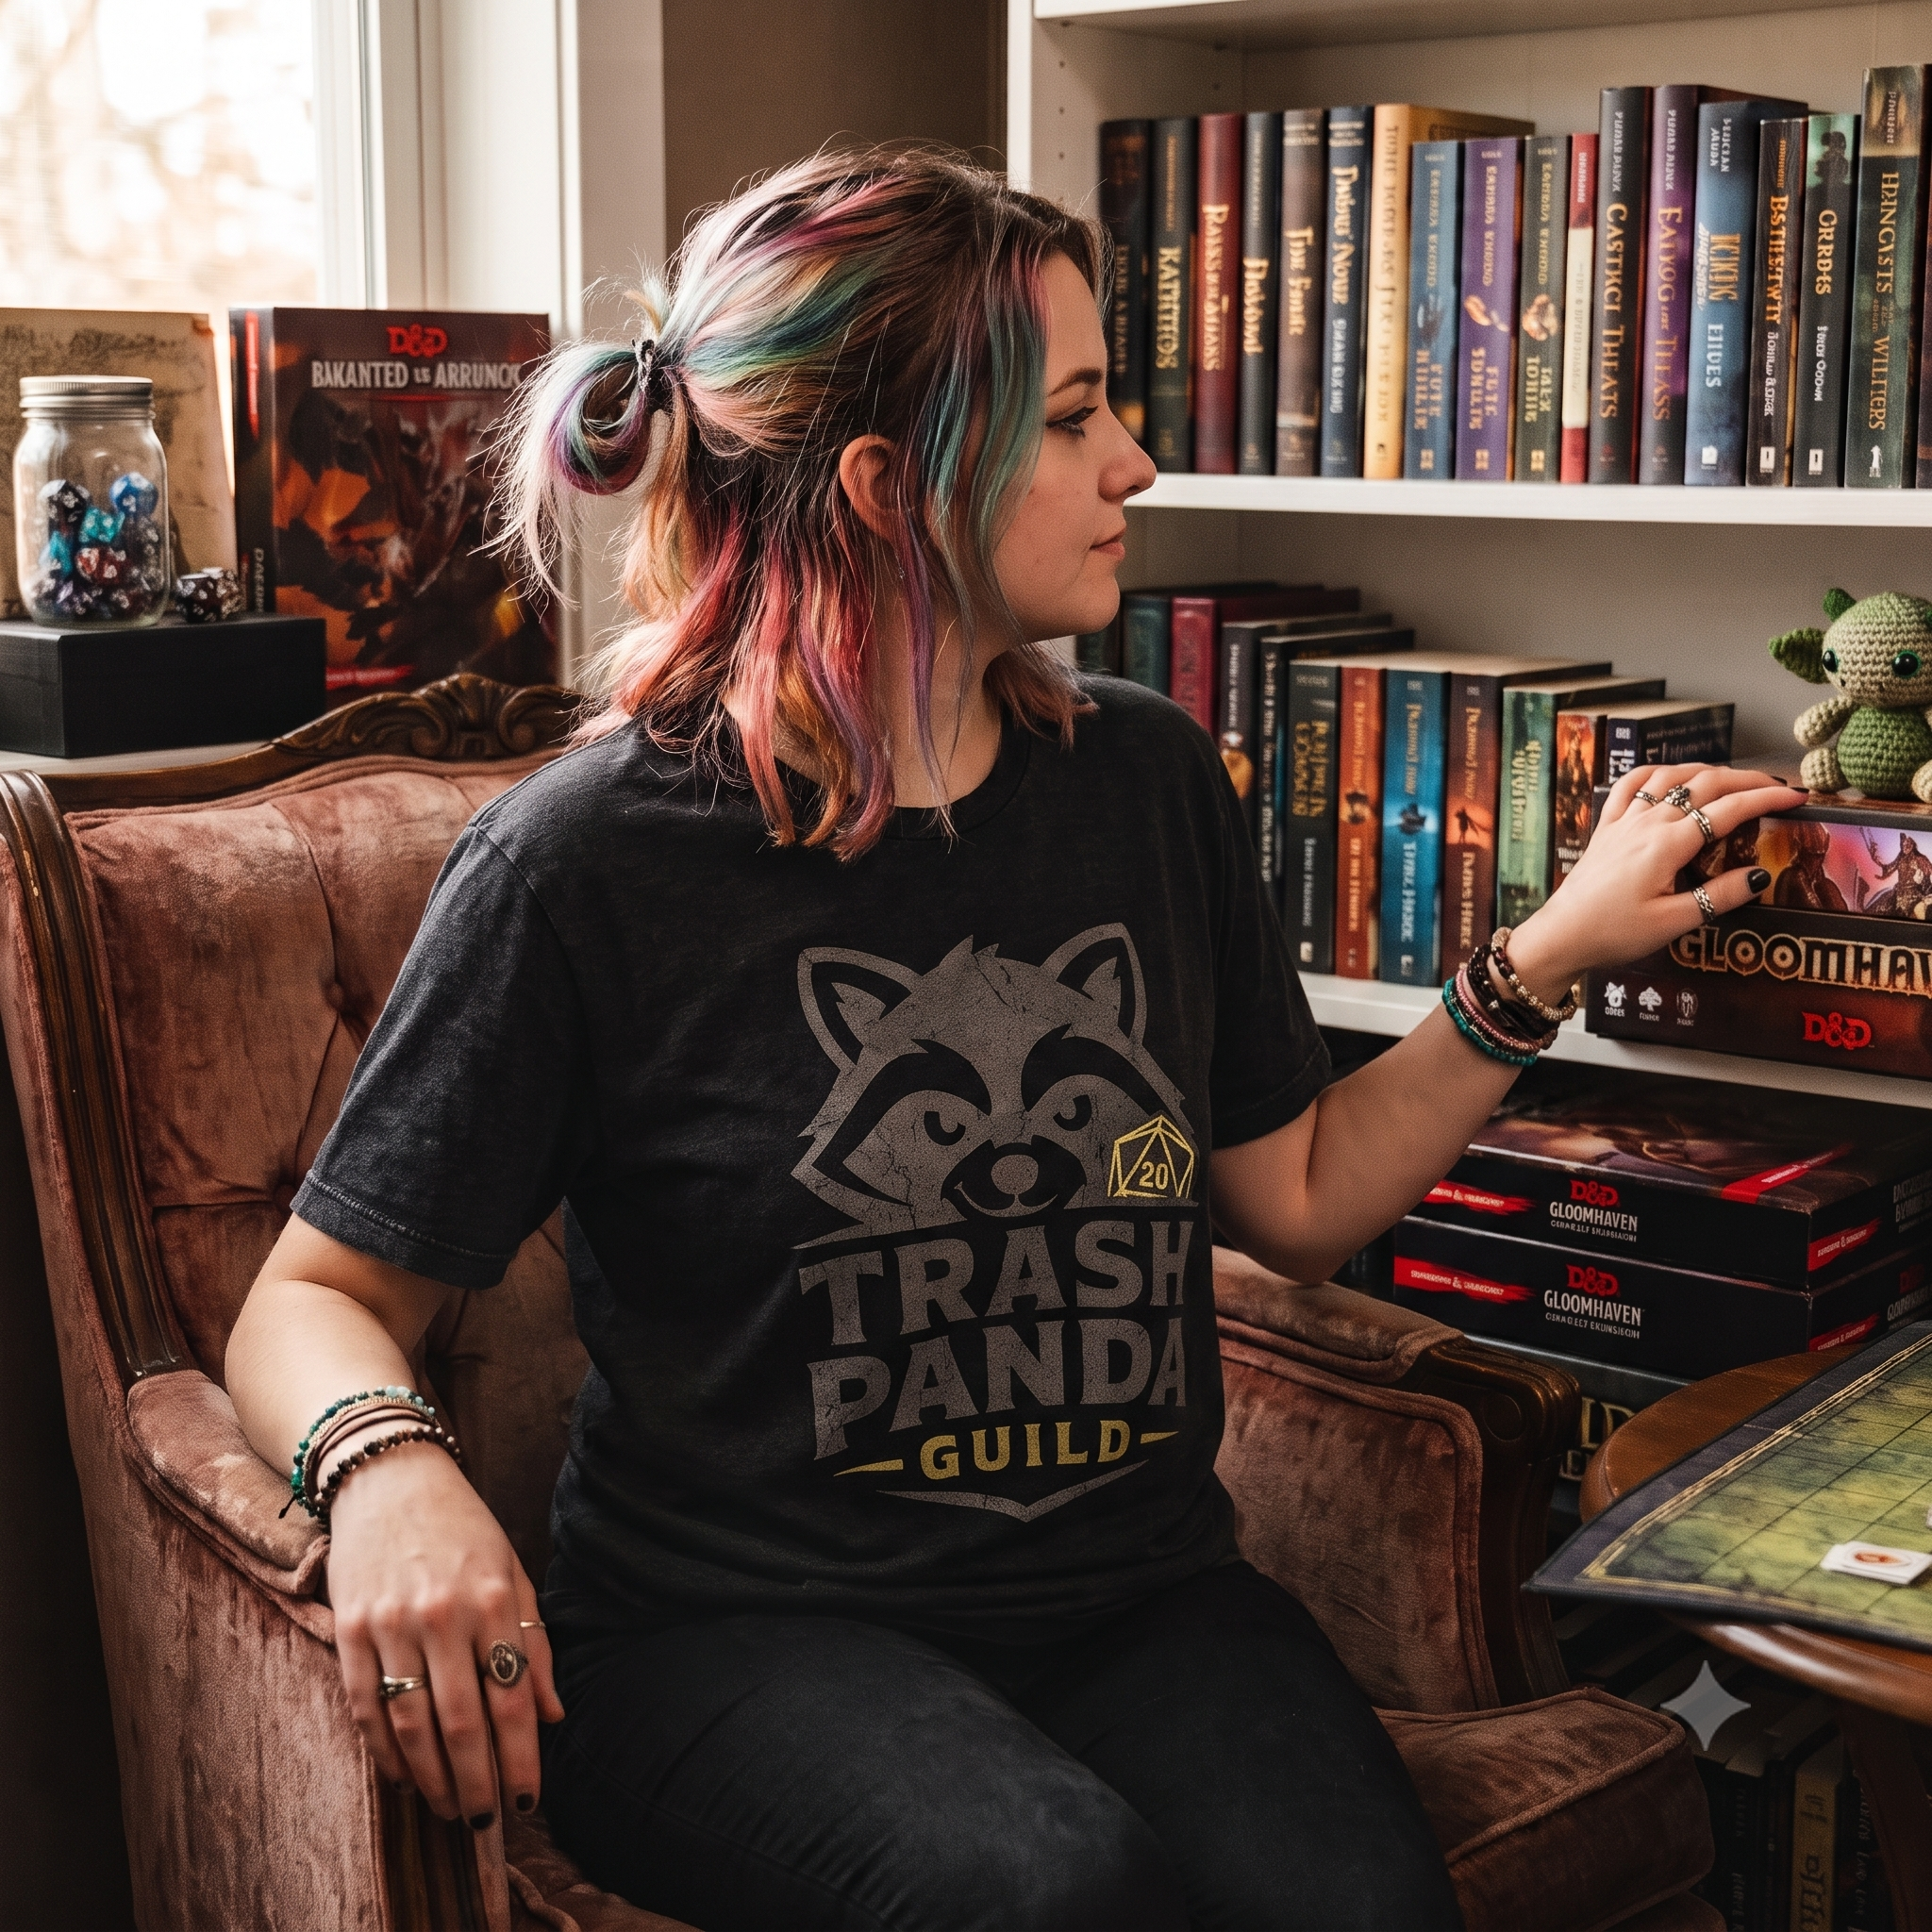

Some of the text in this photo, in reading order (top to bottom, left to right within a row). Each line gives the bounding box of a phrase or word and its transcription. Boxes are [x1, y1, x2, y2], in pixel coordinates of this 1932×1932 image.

[388, 325, 448, 358] D&D
[1801, 1011, 1872, 1051] D&D
[1141, 1161, 1169, 1191] 20
[1570, 1179, 1619, 1208] D&D
[1549, 1201, 1639, 1232] GLOOMHAVEN
[798, 1220, 1195, 1346] TRASH
[1565, 1264, 1618, 1297] D&D
[1543, 1290, 1641, 1326] GLOOMHAVEN
[807, 1317, 1187, 1461] PANDA
[919, 1420, 1132, 1480] GUILD
